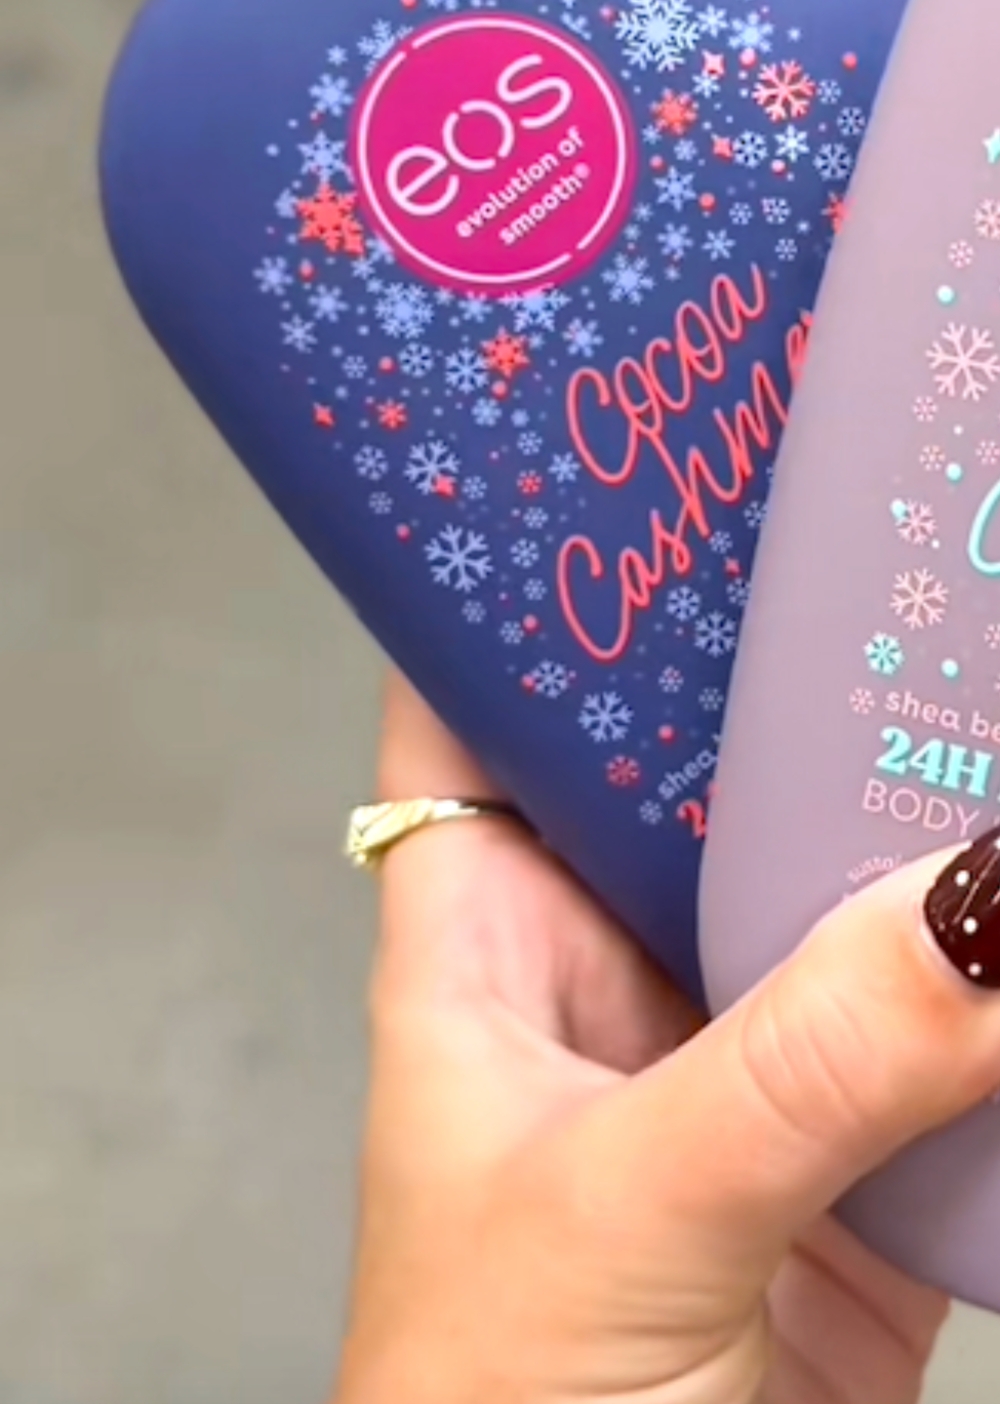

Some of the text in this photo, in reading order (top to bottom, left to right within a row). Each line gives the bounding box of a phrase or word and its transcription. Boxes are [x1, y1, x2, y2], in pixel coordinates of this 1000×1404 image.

[386, 53, 573, 216] eos
[456, 125, 585, 238] evolution of
[566, 262, 767, 485] Cocoa
[885, 691, 961, 730] shea
[657, 749, 719, 800] shea
[875, 725, 993, 797] 24H
[862, 777, 981, 838] BODY
